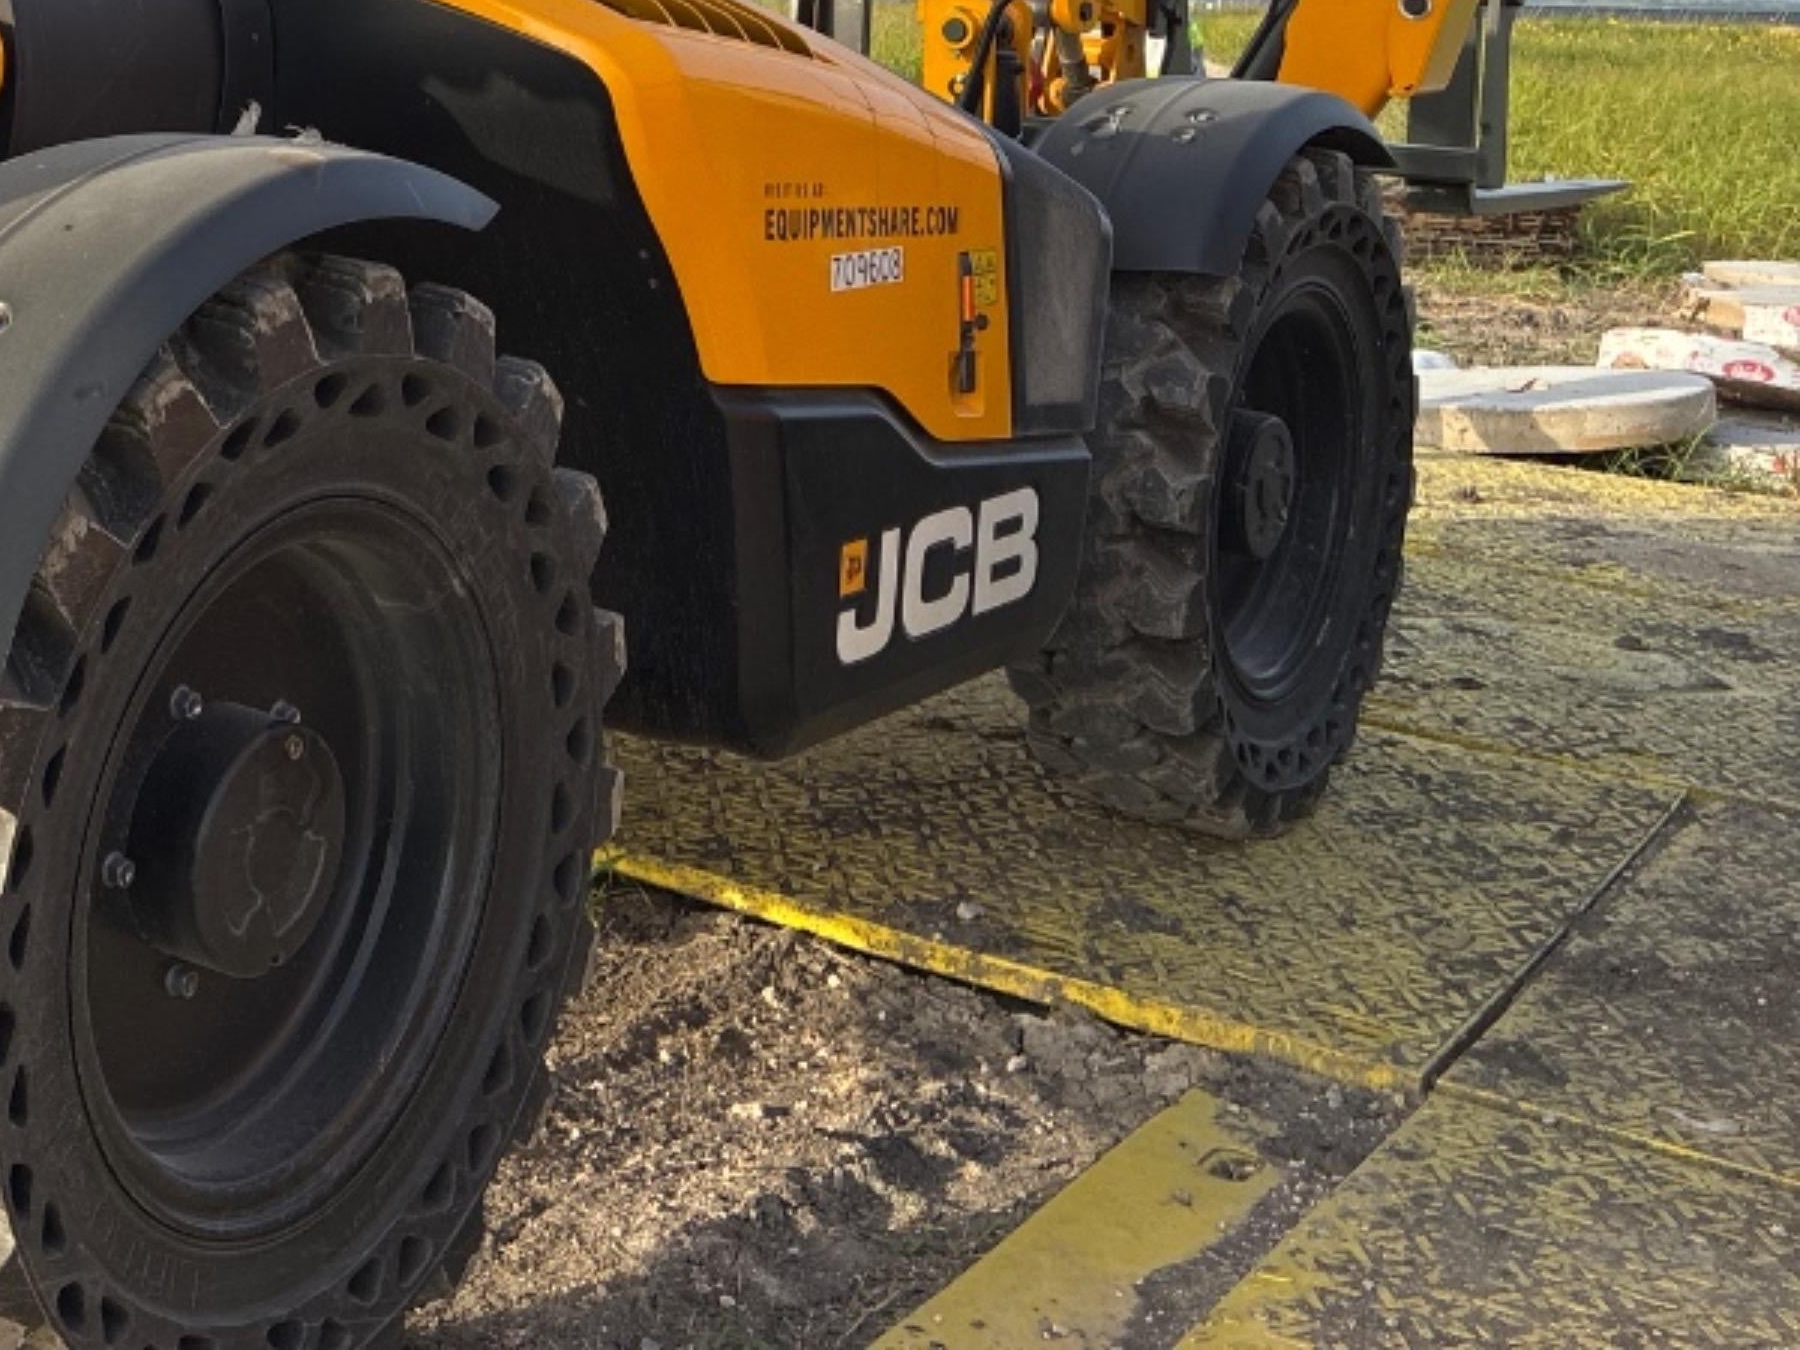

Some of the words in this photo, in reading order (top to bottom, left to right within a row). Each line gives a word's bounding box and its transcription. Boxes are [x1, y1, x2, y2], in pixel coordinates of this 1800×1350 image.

[764, 206, 959, 241] EQUIPMENTSHARE.COM
[833, 248, 902, 287] 709608
[836, 485, 1040, 666] JCB
